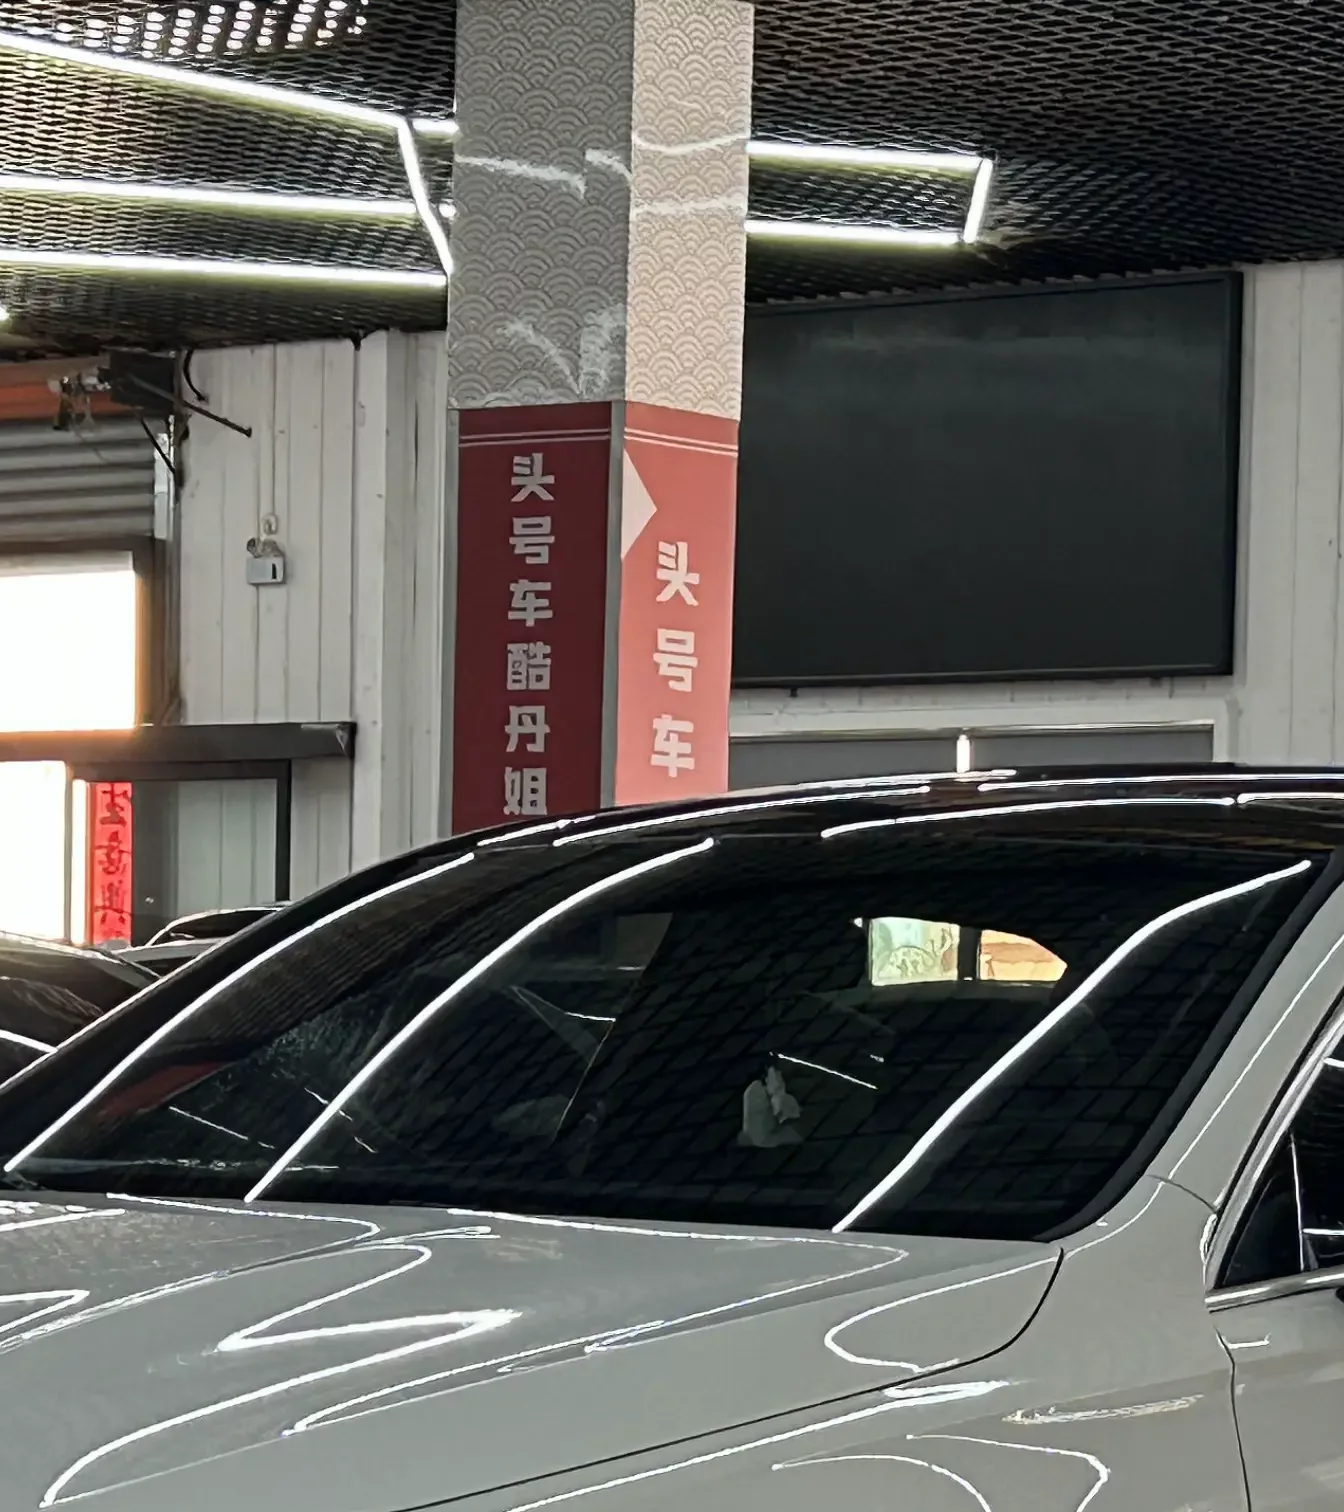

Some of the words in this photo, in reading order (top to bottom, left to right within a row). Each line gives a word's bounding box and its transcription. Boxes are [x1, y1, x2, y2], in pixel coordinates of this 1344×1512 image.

[503, 453, 556, 816] 头号车酷丹姐
[650, 541, 700, 777] 头号车
